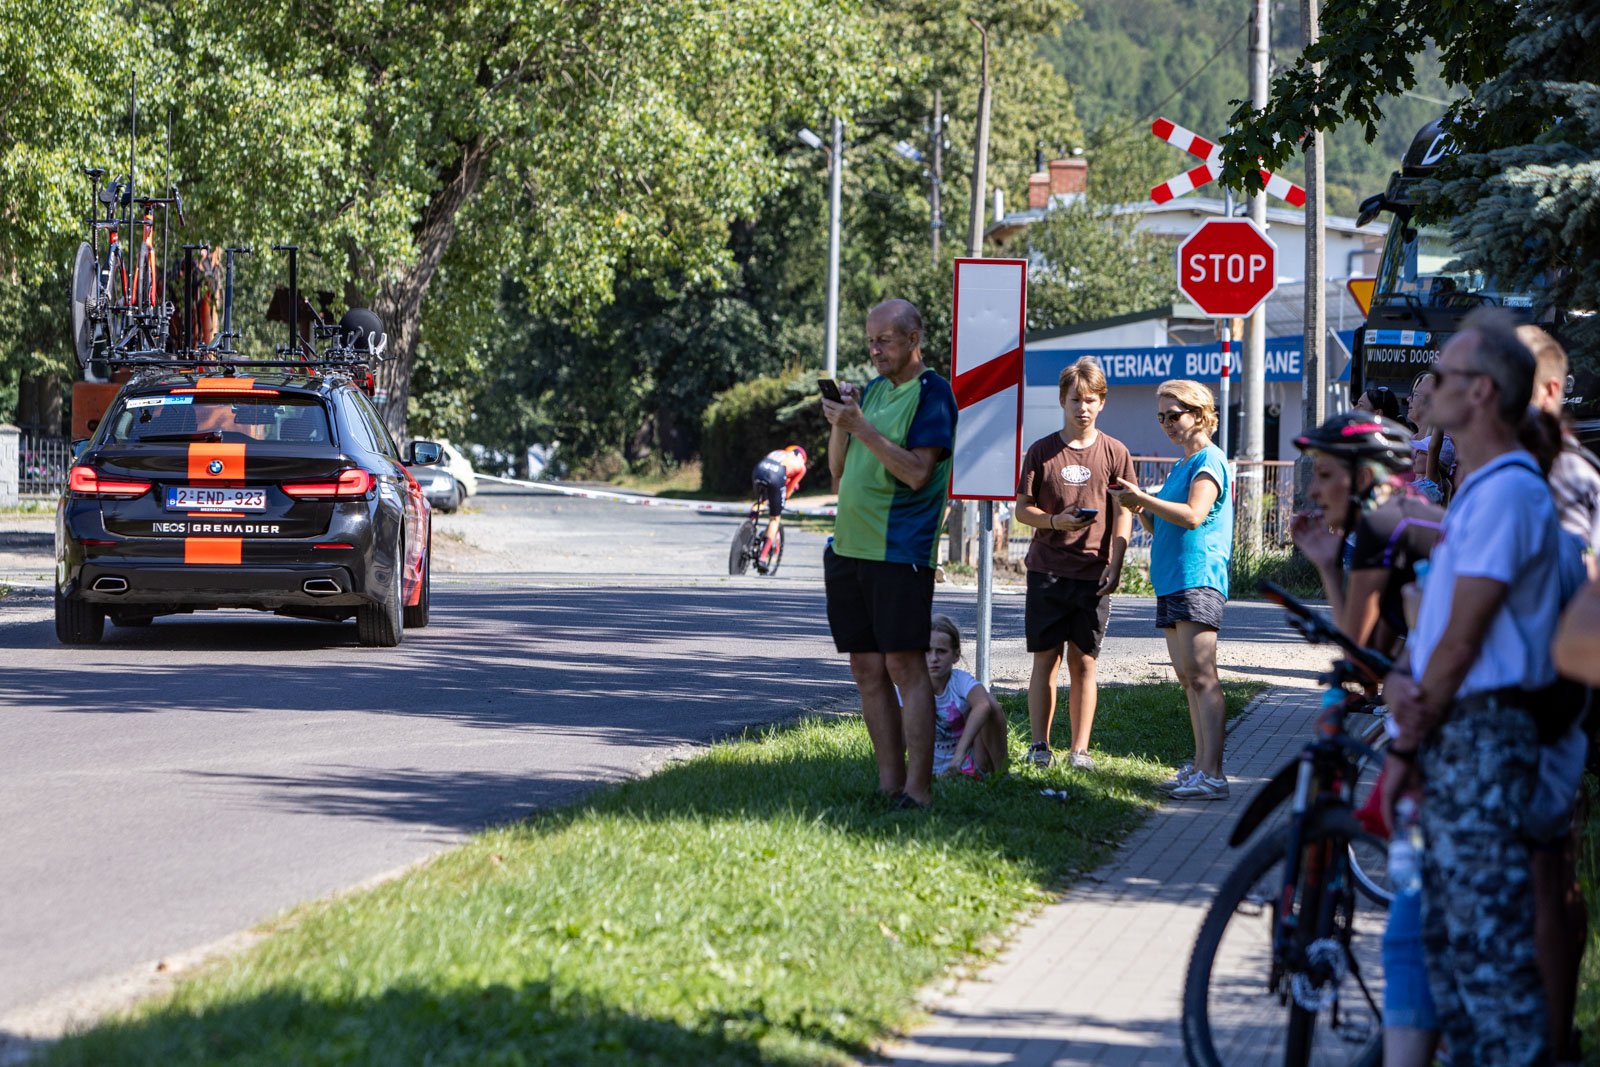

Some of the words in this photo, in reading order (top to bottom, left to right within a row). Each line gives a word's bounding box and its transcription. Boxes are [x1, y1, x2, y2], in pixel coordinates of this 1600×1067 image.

[1189, 253, 1266, 283] STOP
[1095, 353, 1174, 378] ATERIAŁY
[1367, 348, 1406, 363] WINDOWS
[1409, 349, 1440, 364] DOORS
[152, 522, 186, 533] INEOS
[192, 524, 280, 534] GRENADIER
